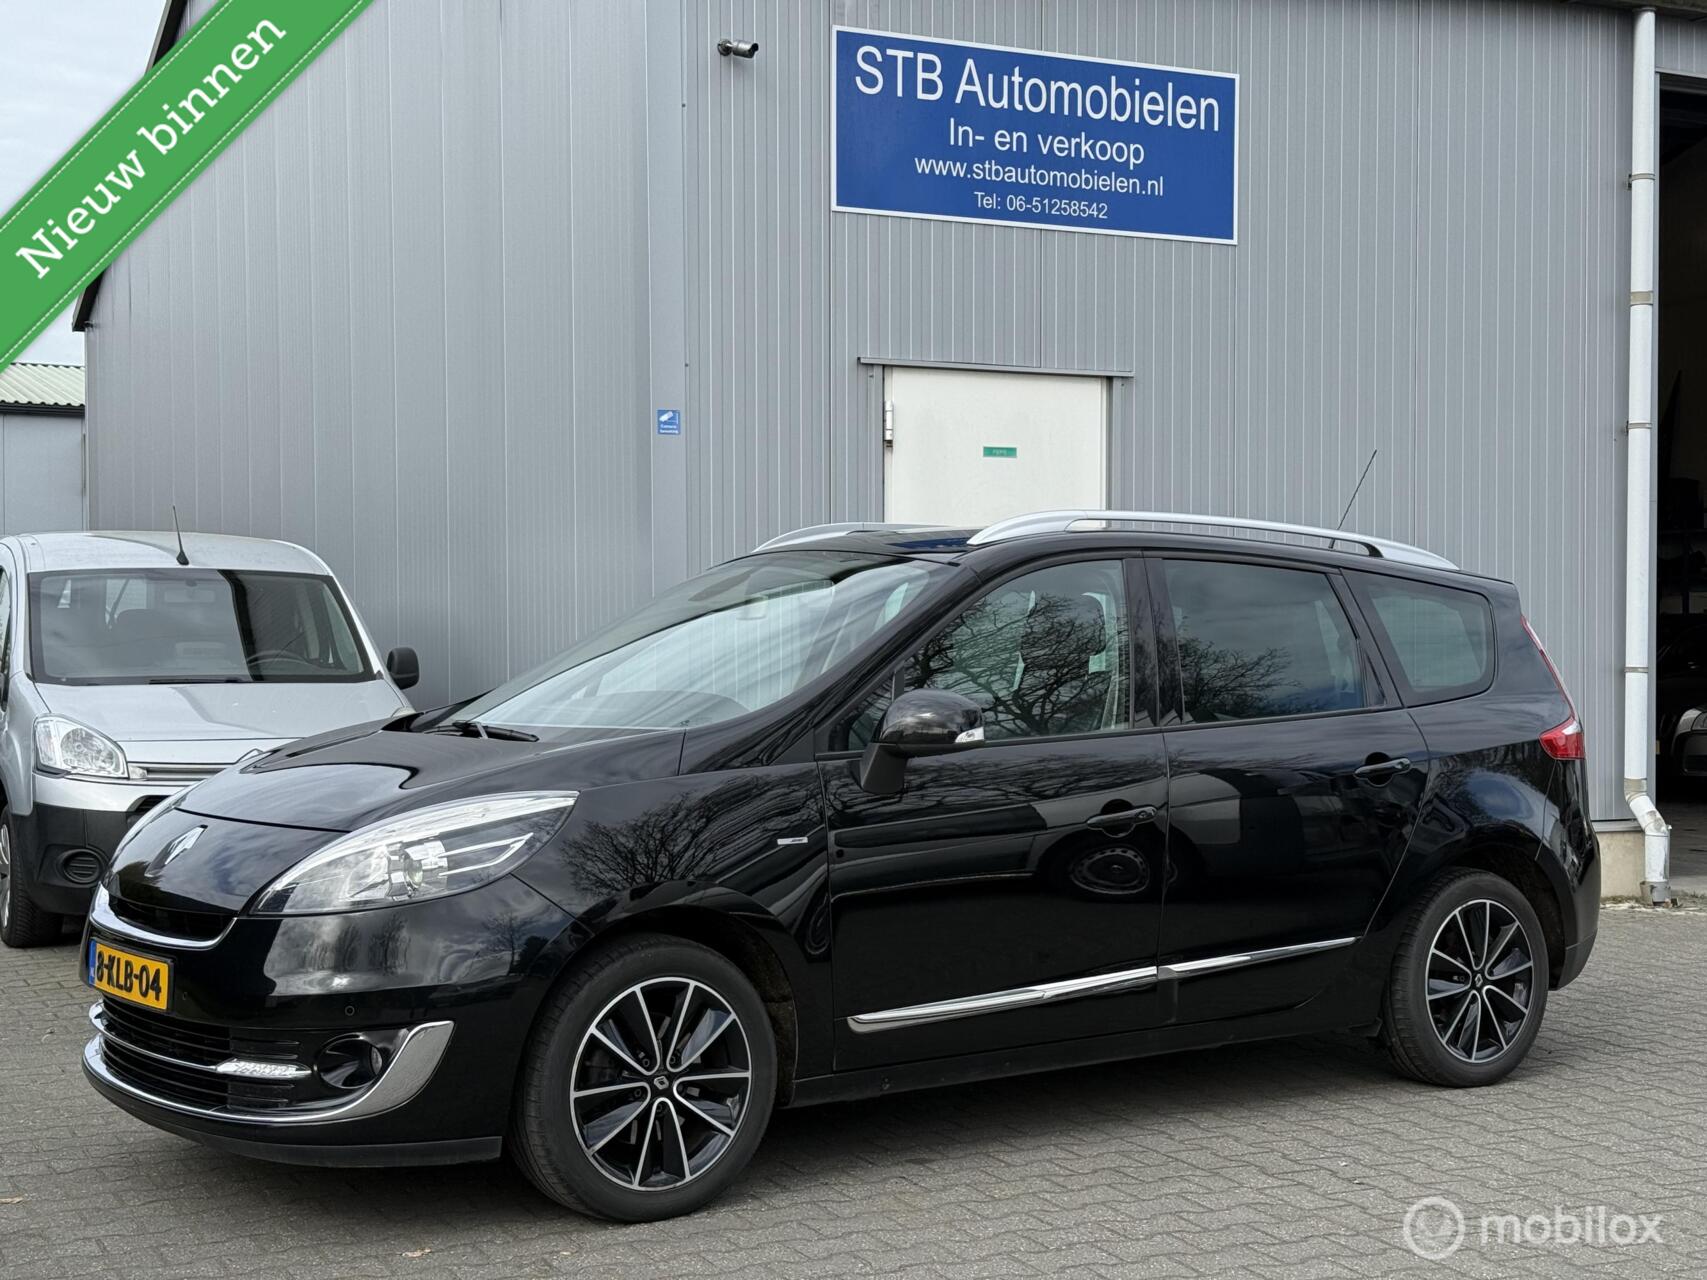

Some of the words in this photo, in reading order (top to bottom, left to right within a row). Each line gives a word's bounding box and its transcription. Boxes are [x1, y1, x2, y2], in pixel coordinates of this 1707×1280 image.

[855, 46, 943, 101] STB
[955, 58, 1219, 132] Automobielen
[949, 117, 985, 147] In-
[994, 129, 1027, 152] en
[1038, 132, 1145, 170] verkoop
[915, 156, 1164, 197] www.stbautomobielen.nl
[974, 191, 1001, 210] Tel:
[1006, 194, 1108, 220] 06-51258542
[96, 950, 162, 1001] 8-KLB-04
